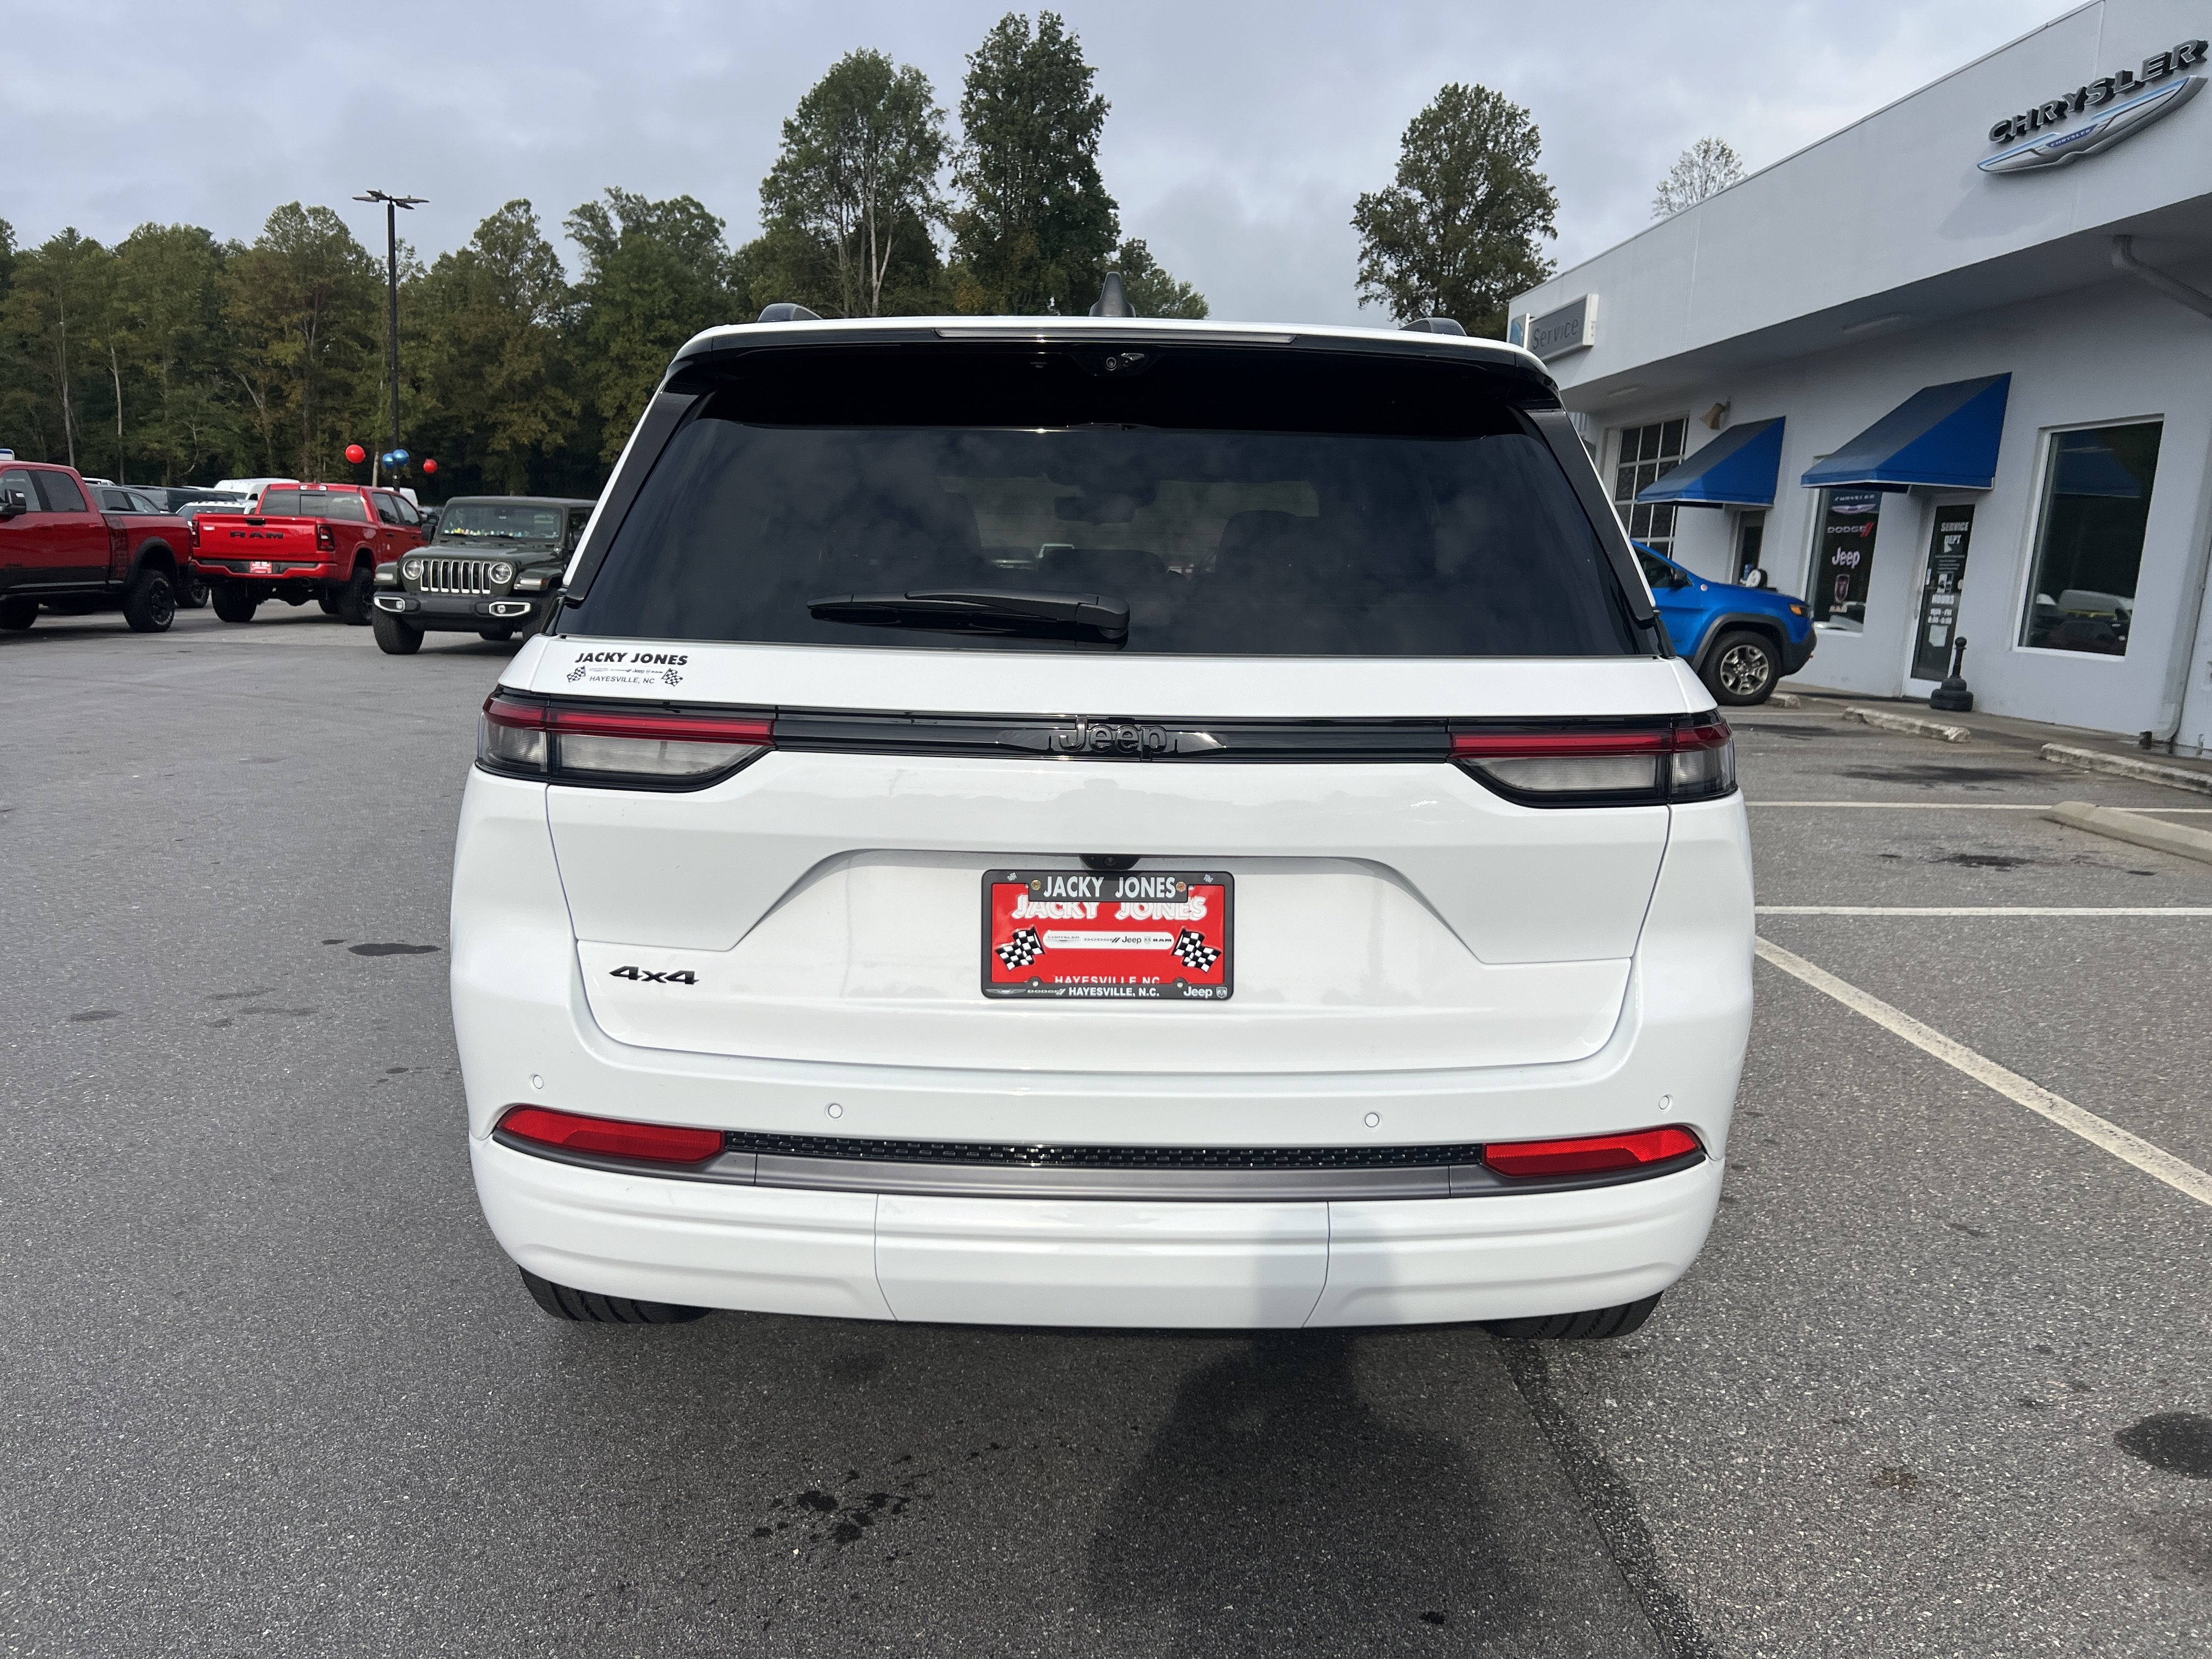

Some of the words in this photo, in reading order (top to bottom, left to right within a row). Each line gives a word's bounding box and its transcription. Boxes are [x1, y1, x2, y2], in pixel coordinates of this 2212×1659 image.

[1988, 39, 2209, 144] CHRYSLER
[2050, 129, 2091, 146] CHRYSLER
[1533, 318, 1579, 349] Service
[230, 531, 284, 539] RAM
[1827, 525, 1867, 534] DODGE
[1941, 521, 1970, 532] SERVICE
[1832, 546, 1860, 569] Jeep
[574, 652, 628, 663] JACKY
[630, 653, 689, 666] JONES
[589, 676, 640, 684] HAYESVILLE,
[1059, 715, 1167, 762] Jeep
[1043, 876, 1104, 898] JACKY
[1115, 876, 1176, 899] JONES
[1011, 894, 1100, 919] JACKY
[1114, 895, 1207, 921] JONES
[1121, 936, 1142, 945] Jeep
[609, 966, 699, 985] 4x4
[1069, 987, 1136, 997] HAYESVILLE,
[1138, 988, 1160, 997] N.C.
[1183, 986, 1213, 998] Jeep
